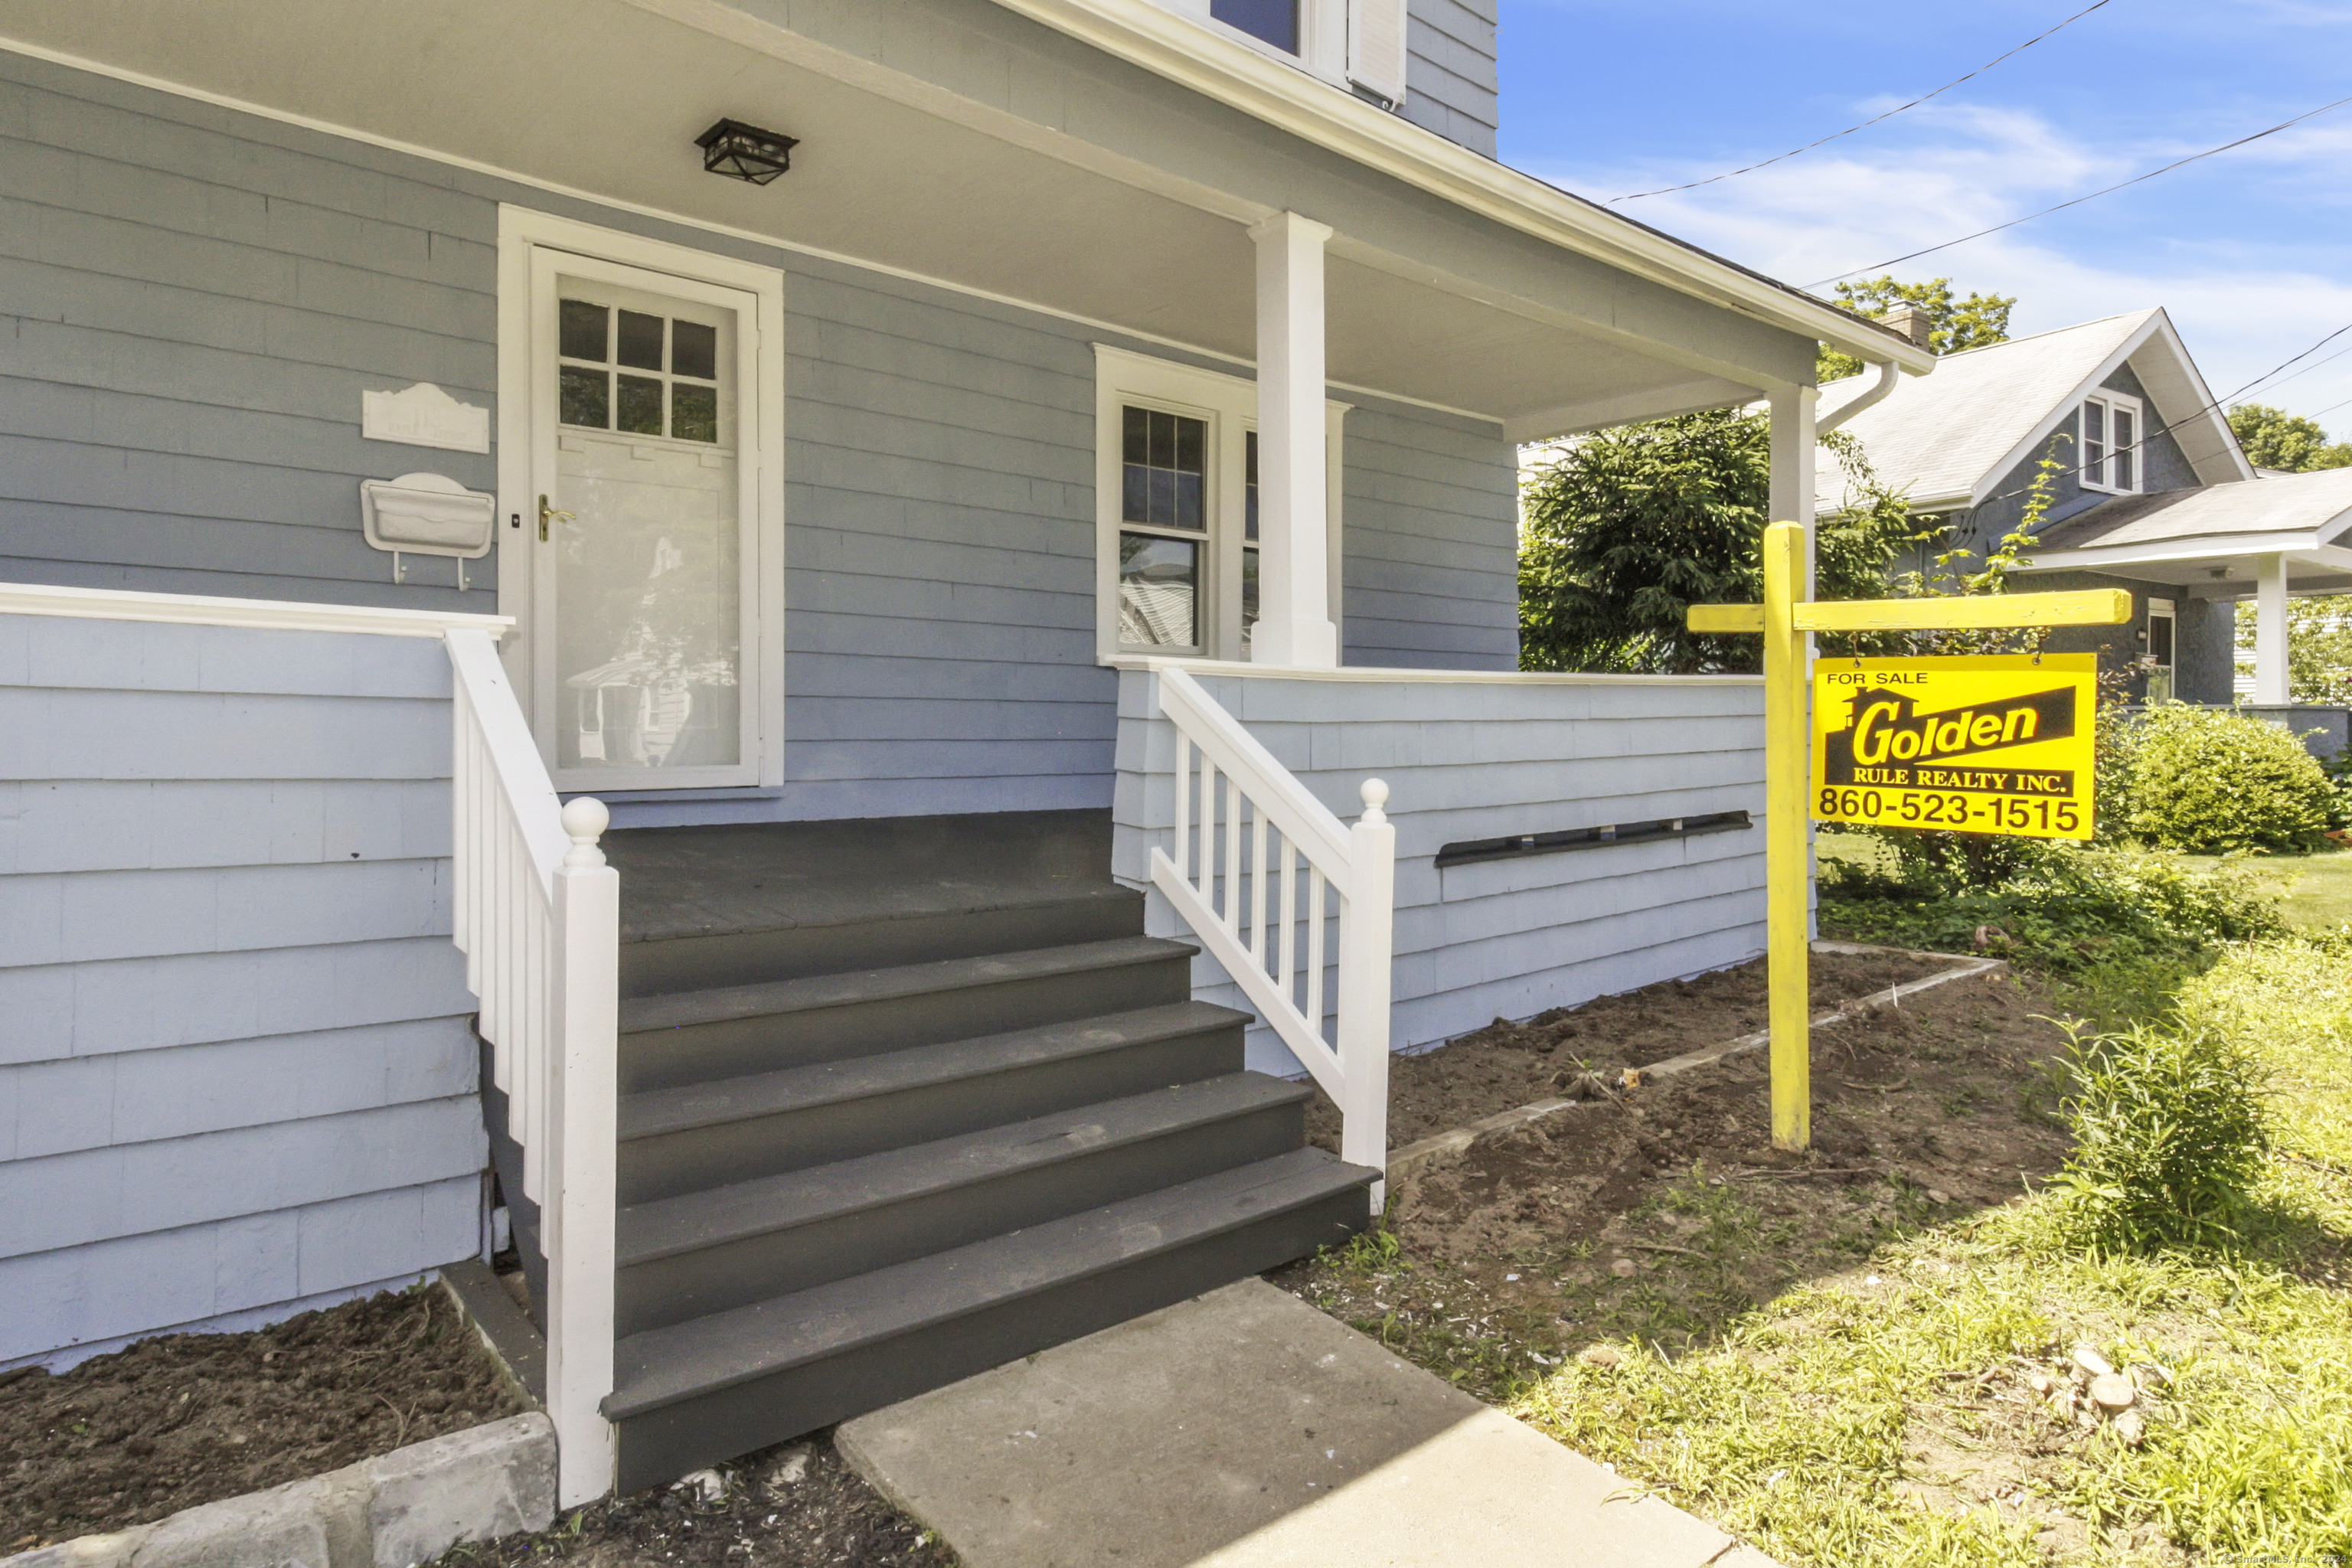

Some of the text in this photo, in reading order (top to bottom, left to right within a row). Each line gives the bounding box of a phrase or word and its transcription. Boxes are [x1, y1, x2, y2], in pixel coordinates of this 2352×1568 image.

[1827, 672, 1928, 684] FOR SALE
[1853, 701, 2040, 766] Golden
[1854, 767, 2066, 792] RULE REALTY INC.
[1819, 788, 2079, 831] 860-523-1515
